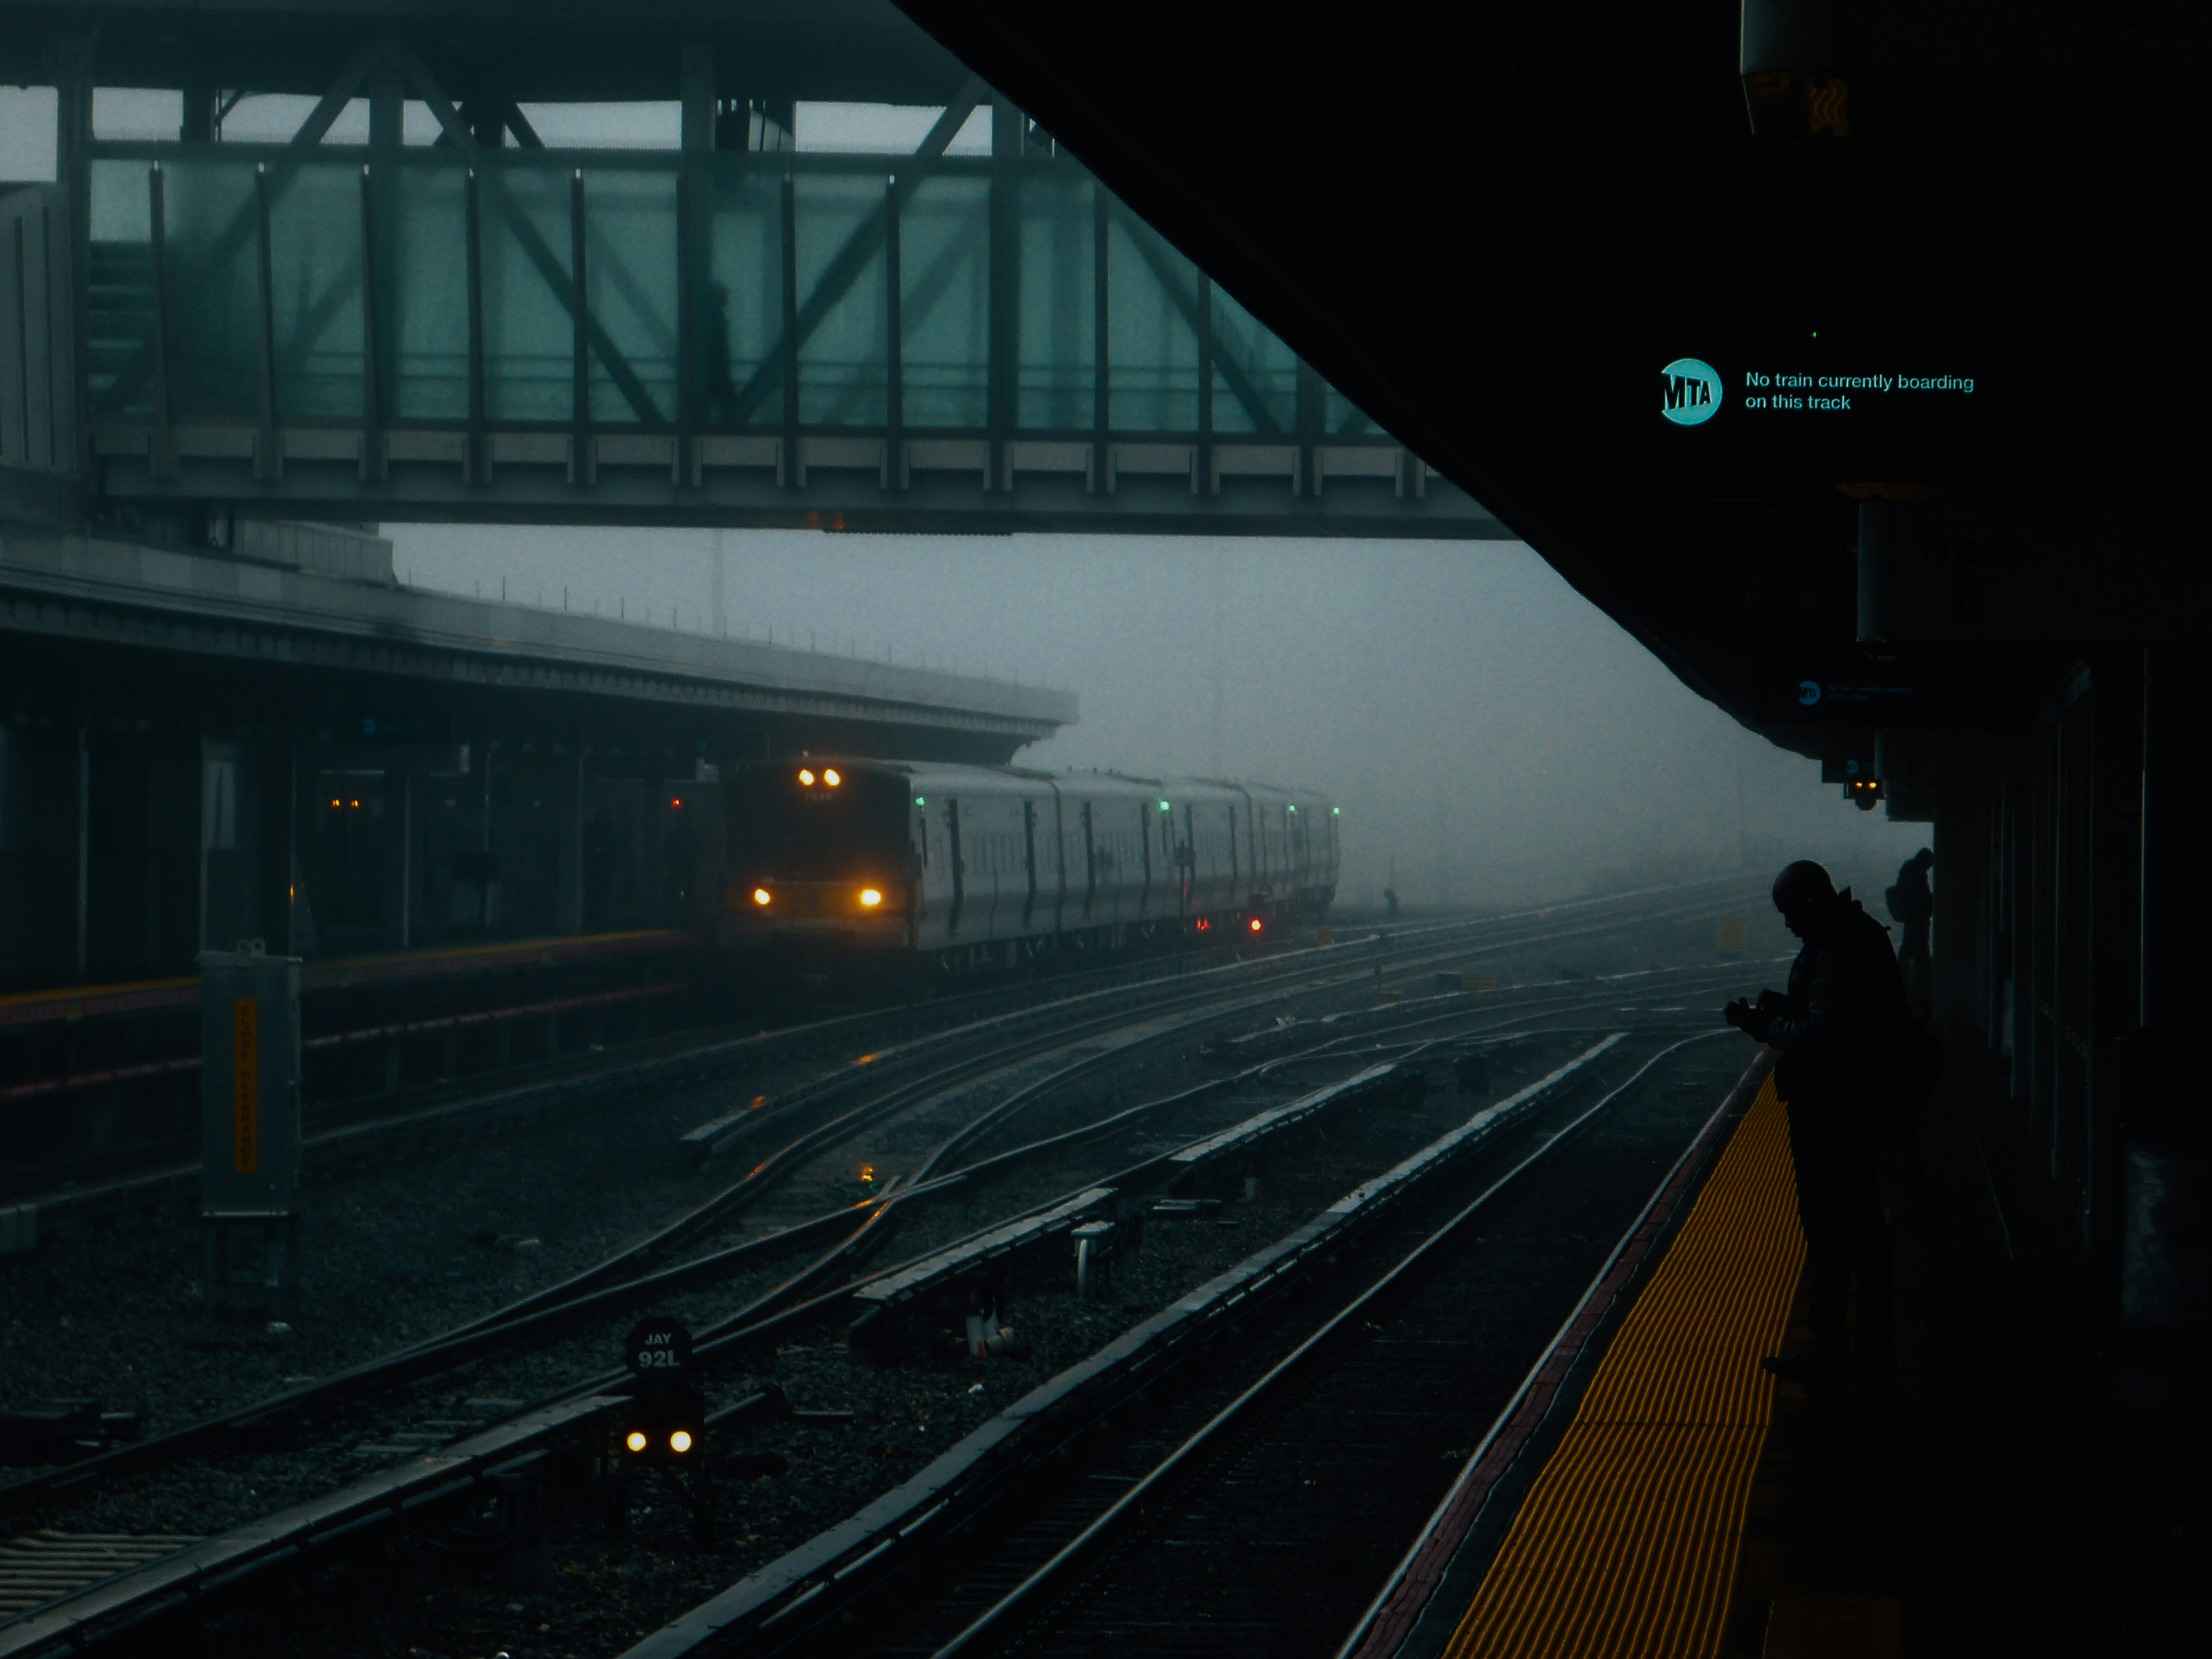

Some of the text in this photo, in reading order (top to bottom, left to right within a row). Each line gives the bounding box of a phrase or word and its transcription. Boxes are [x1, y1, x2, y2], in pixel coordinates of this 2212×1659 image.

[1662, 374, 1712, 411] MTA
[1746, 371, 1975, 393] No train currently boarding
[1746, 394, 1851, 410] on this track
[1913, 532, 2024, 565] Track
[1950, 571, 1987, 624] 8
[644, 1333, 672, 1346] JAY
[638, 1349, 681, 1368] 92L
